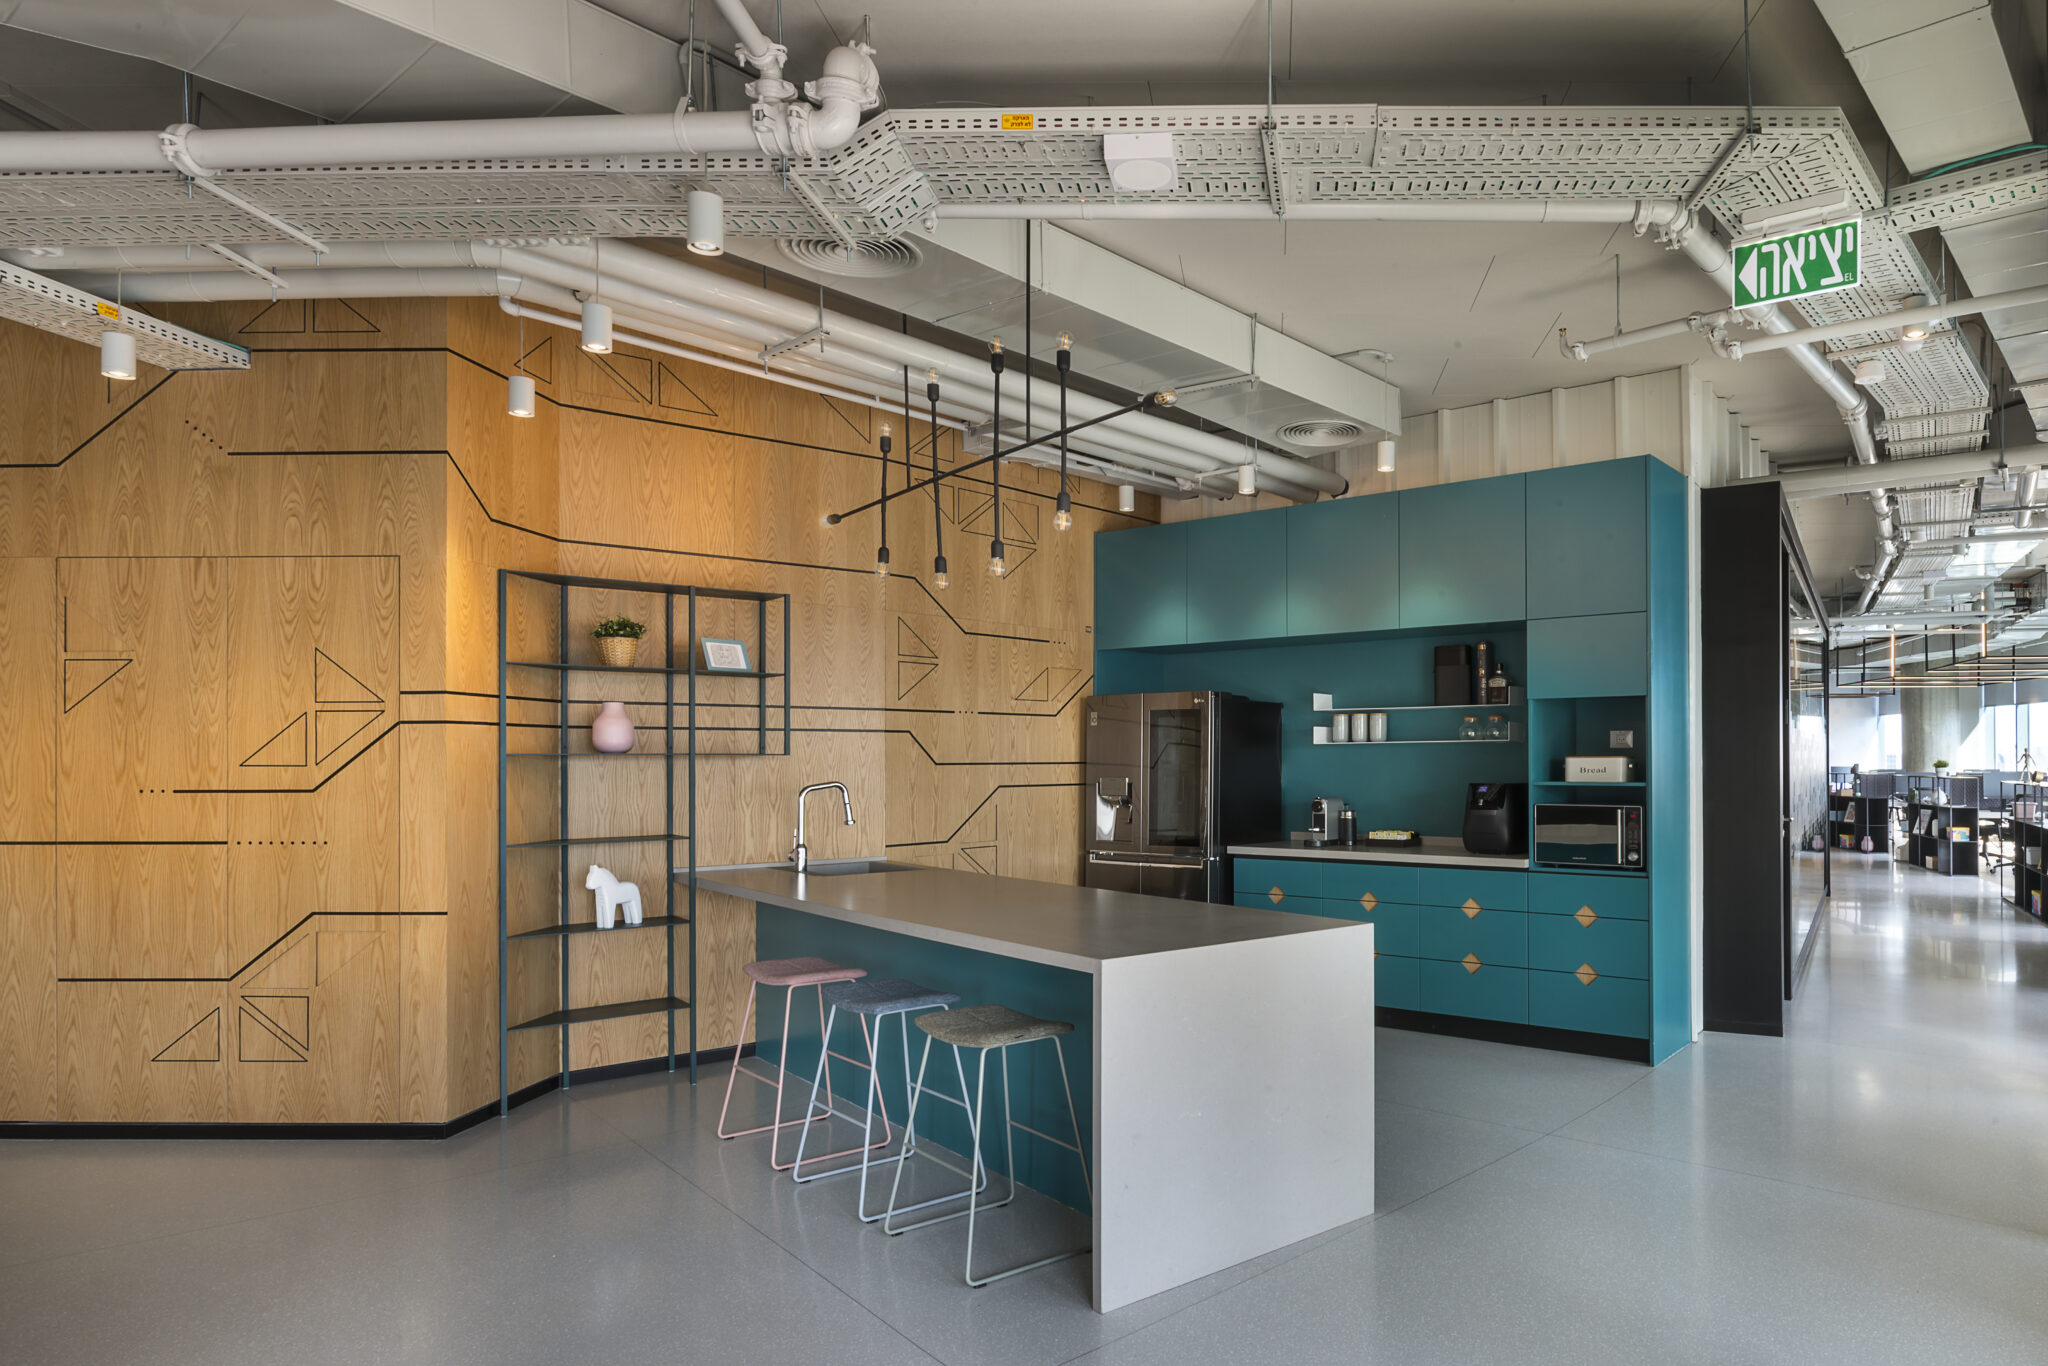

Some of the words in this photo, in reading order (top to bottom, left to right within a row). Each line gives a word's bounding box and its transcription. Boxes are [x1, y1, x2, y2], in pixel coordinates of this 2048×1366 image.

[1759, 226, 1854, 298] יציאה
[1844, 272, 1854, 282] EL
[1579, 766, 1607, 774] Bread
